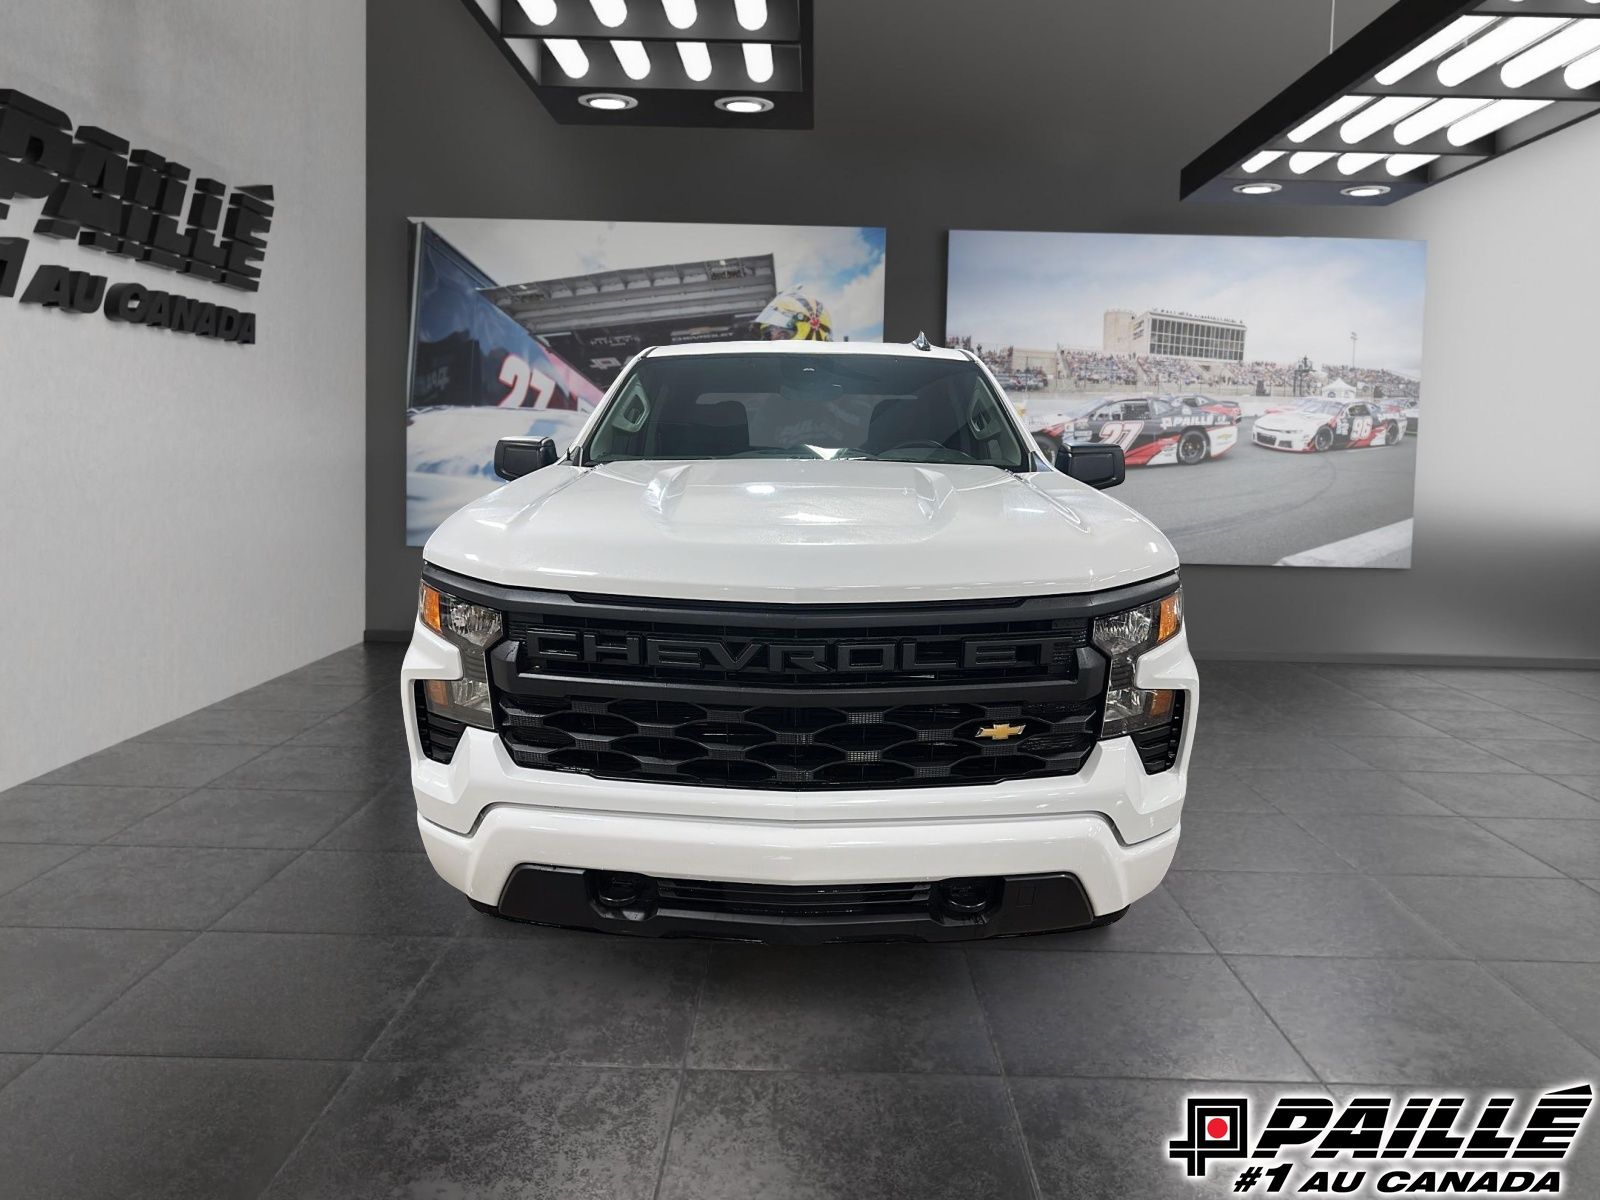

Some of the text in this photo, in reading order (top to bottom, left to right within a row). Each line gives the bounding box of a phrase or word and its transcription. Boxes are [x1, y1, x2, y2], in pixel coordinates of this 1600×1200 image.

[19, 265, 108, 313] AU
[104, 283, 256, 344] CANADA
[498, 354, 557, 409] 27
[1099, 420, 1145, 454] 27
[1351, 416, 1372, 439] 96
[526, 628, 1074, 673] CHEVROLET
